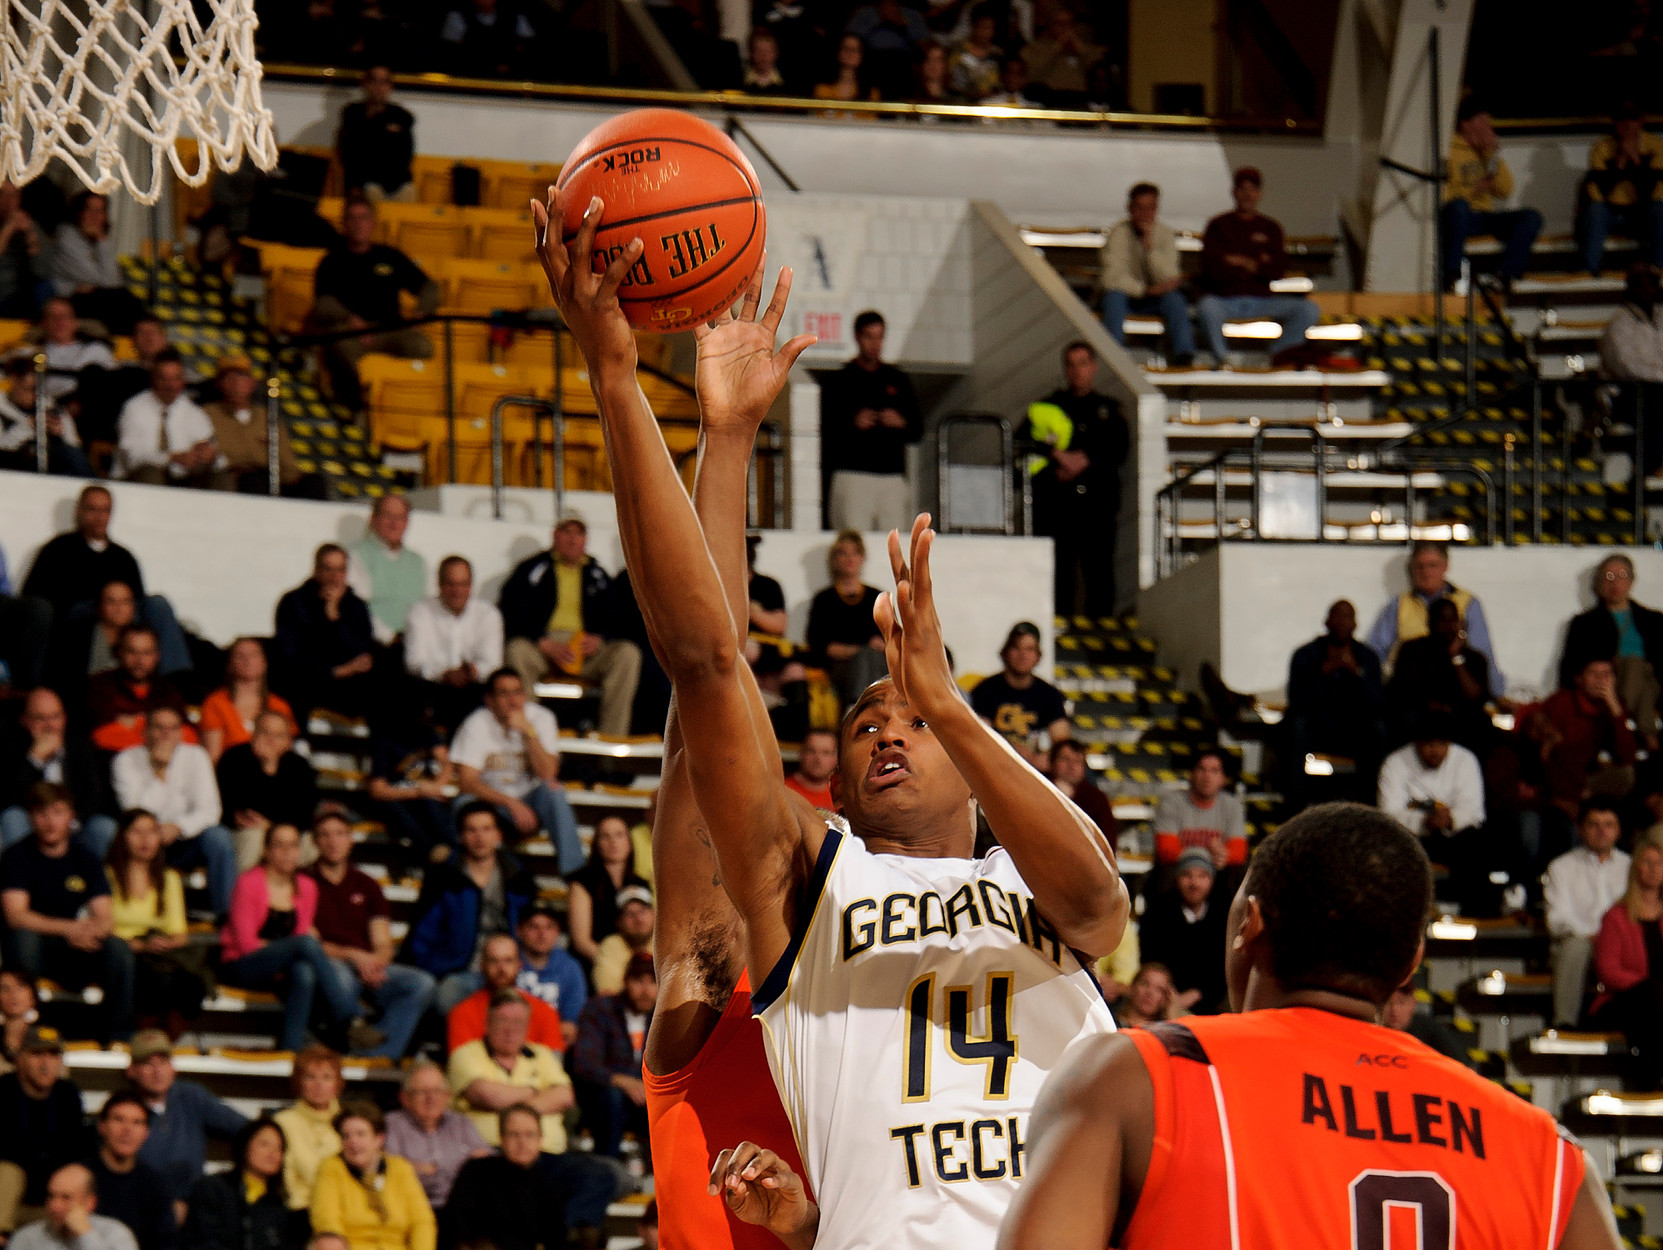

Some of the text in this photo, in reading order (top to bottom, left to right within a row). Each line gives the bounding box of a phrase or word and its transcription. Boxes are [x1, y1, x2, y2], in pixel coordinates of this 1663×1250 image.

[602, 146, 662, 174] ROCK
[659, 223, 728, 280] THE
[901, 970, 1019, 1104] 14
[1355, 1053, 1408, 1069] ACC
[1301, 1072, 1487, 1161] ALLEN
